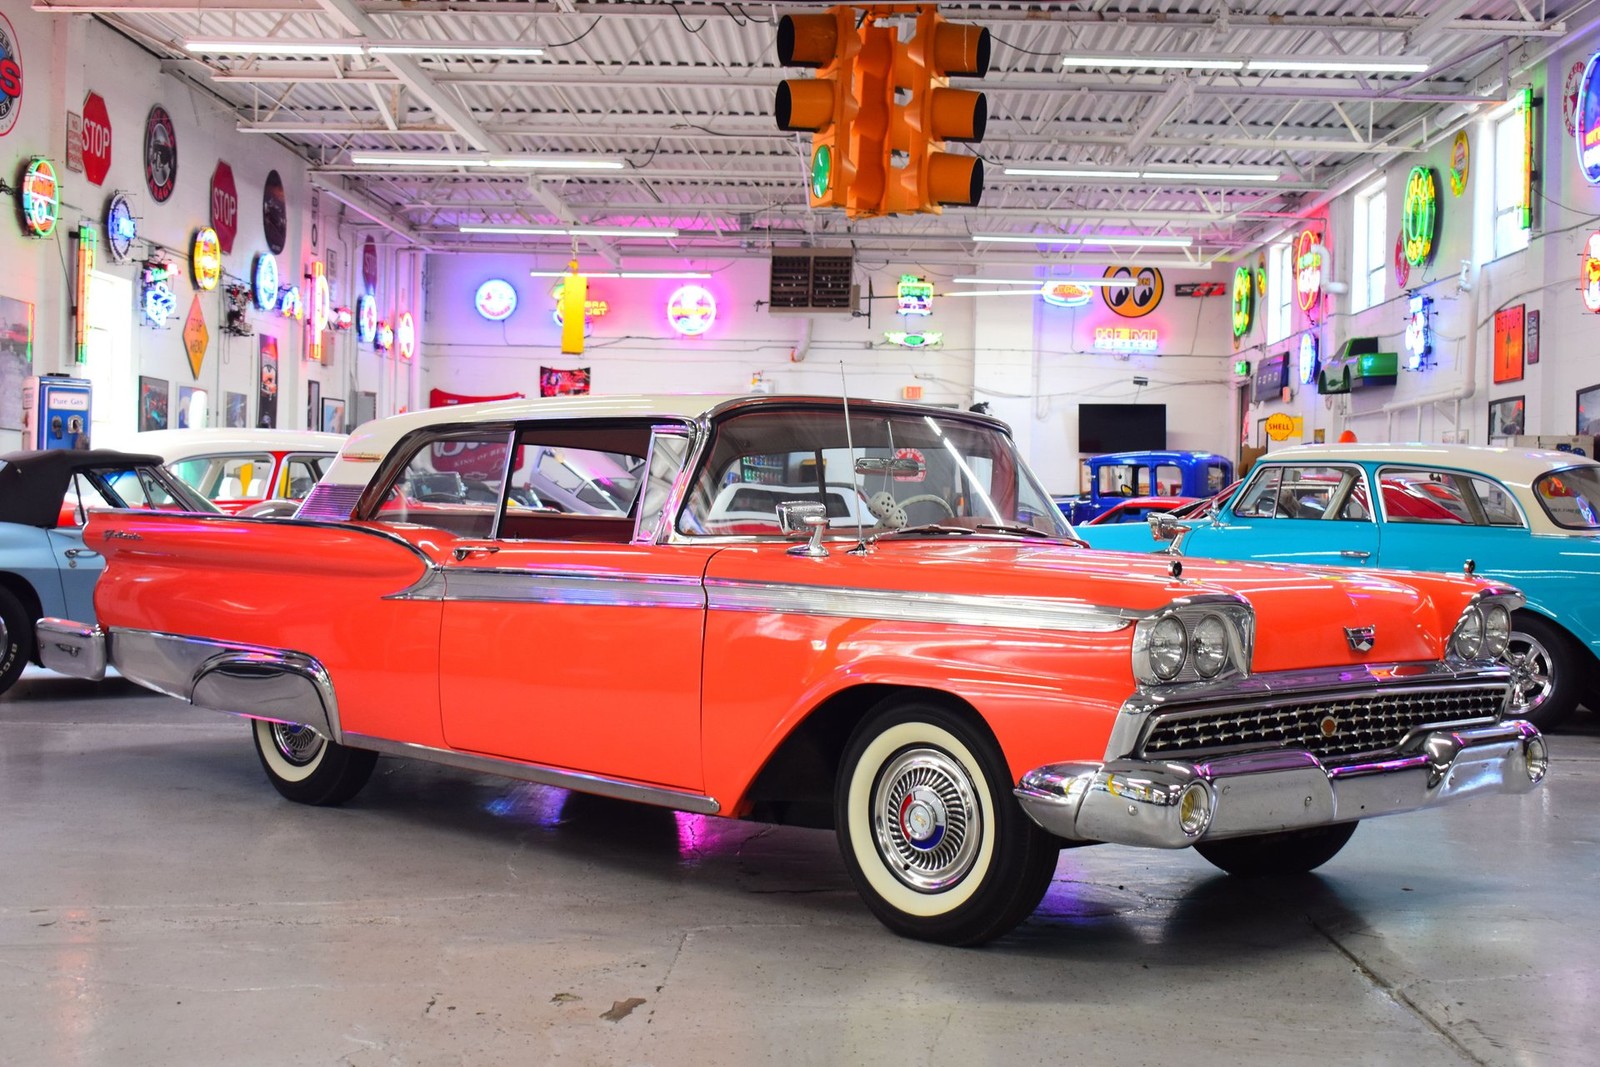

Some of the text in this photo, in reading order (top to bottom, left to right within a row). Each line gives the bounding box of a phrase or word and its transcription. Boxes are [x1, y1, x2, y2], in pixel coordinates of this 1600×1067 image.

[82, 118, 110, 159] STOP
[213, 188, 237, 227] STOP
[584, 301, 607, 309] BRA
[1095, 328, 1158, 341] HEMI
[1268, 423, 1290, 431] SHELL
